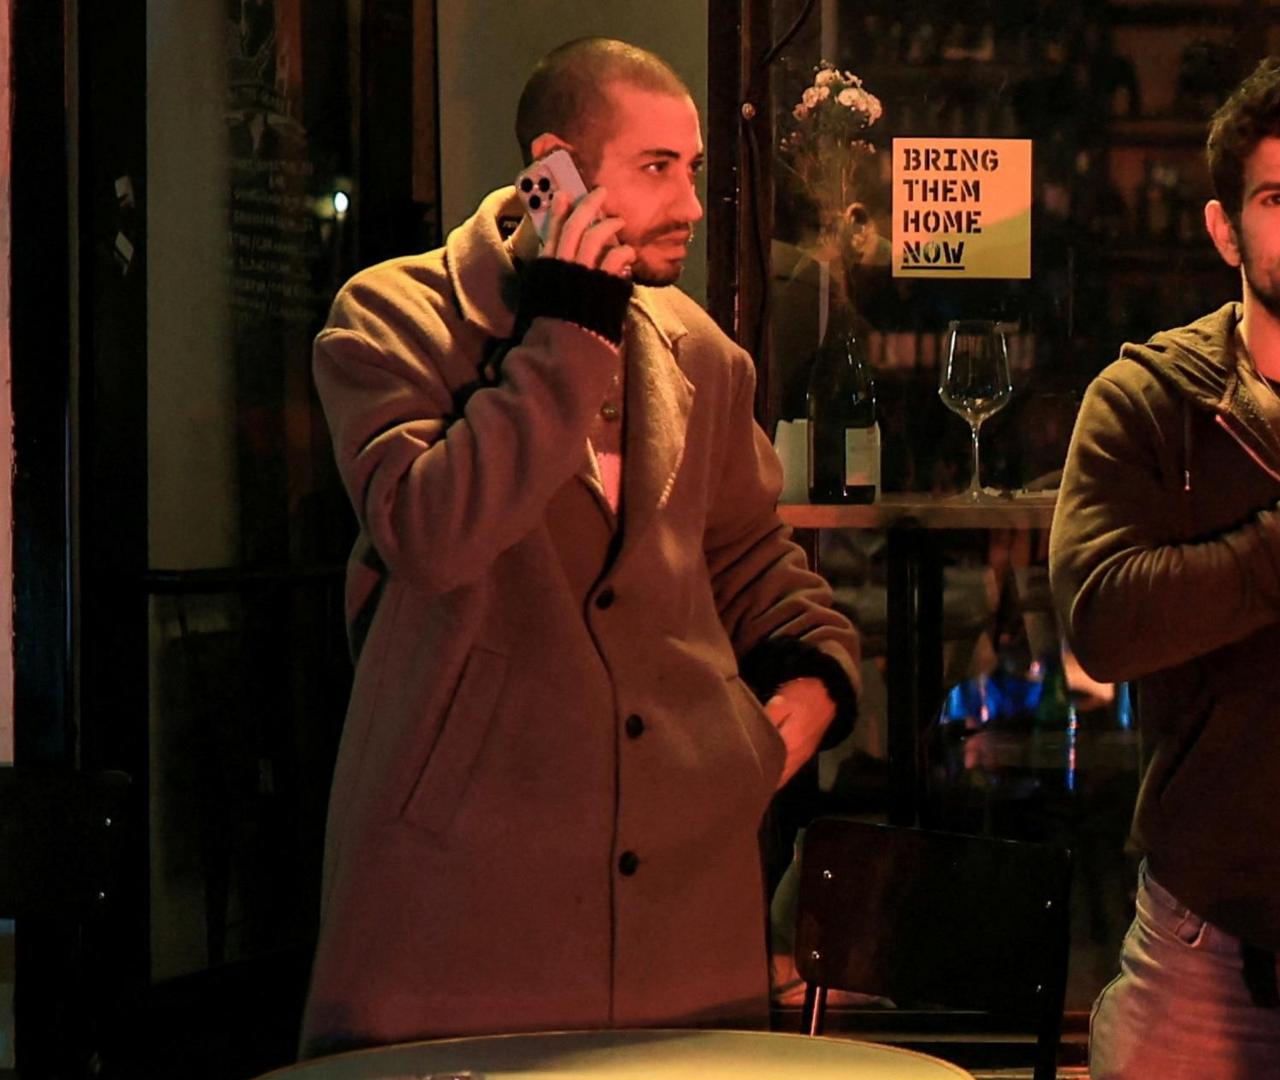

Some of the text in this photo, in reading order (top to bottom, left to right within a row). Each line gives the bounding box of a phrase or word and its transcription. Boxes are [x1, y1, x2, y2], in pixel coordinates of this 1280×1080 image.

[903, 148, 999, 172] BRING
[903, 179, 981, 202] THEM
[903, 210, 982, 234] HOME
[903, 241, 965, 264] NOW
